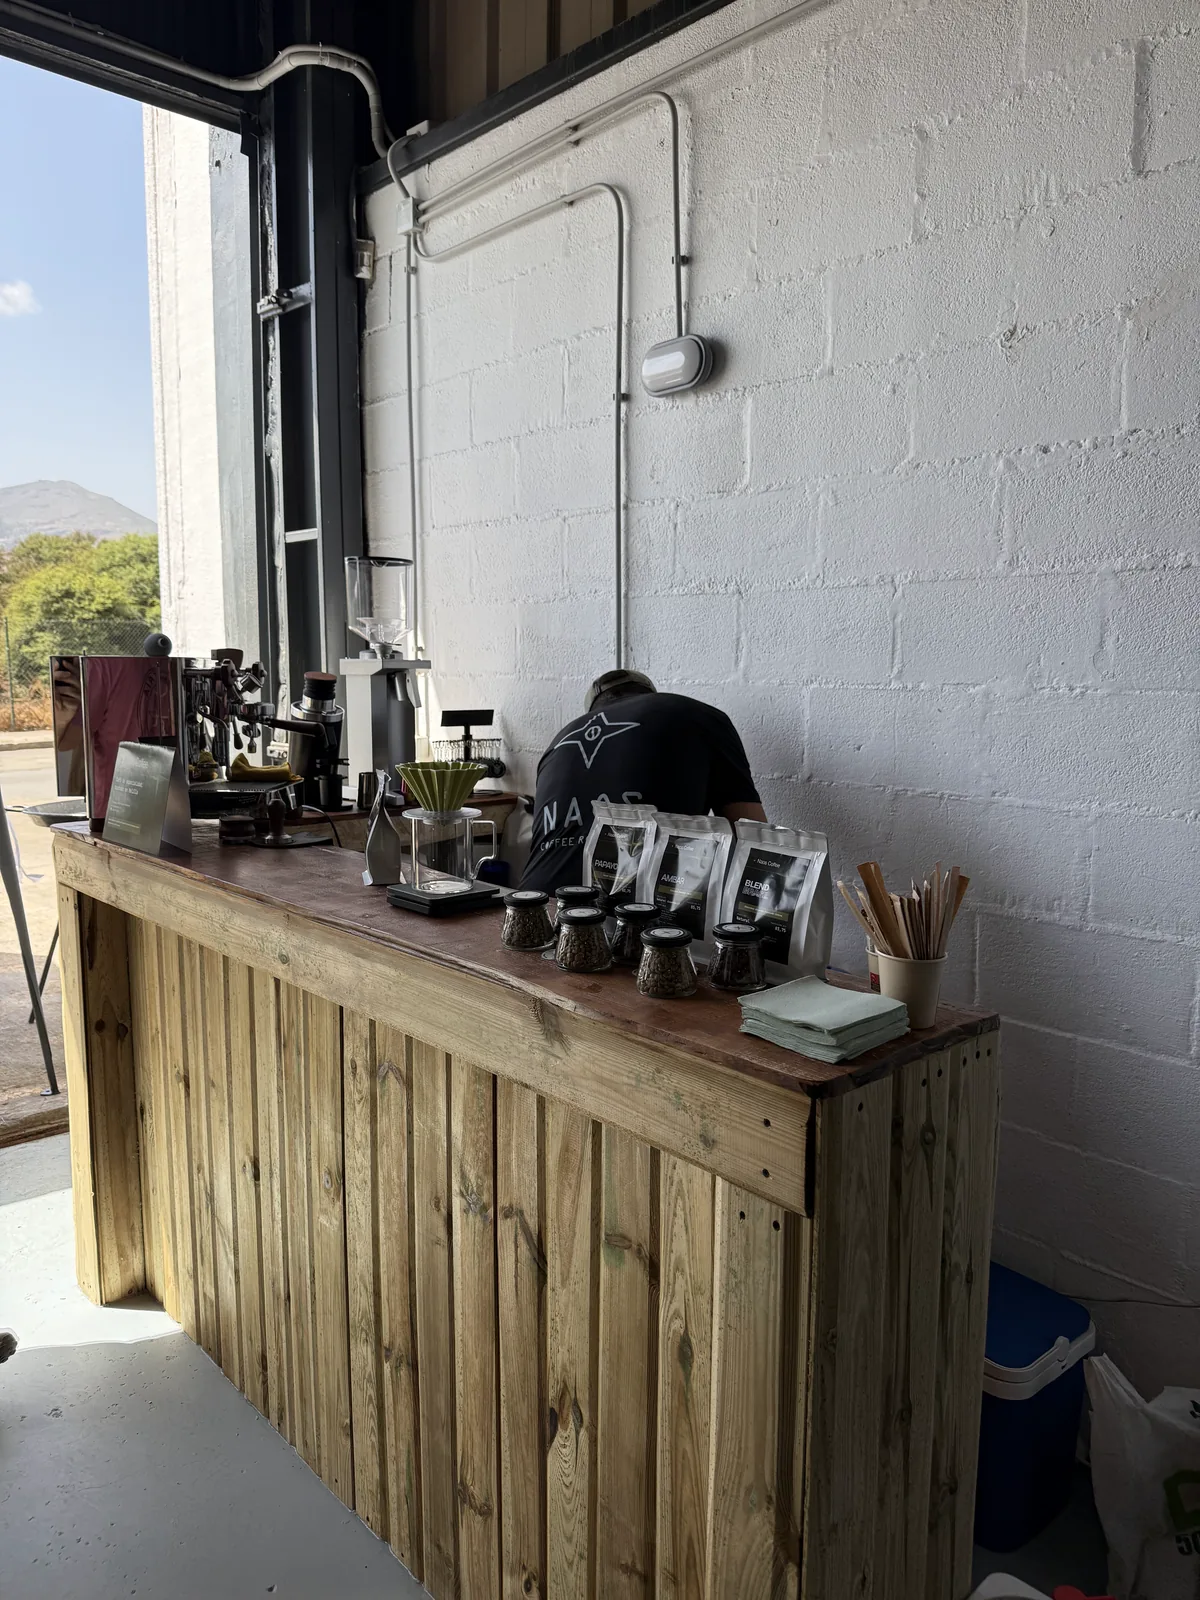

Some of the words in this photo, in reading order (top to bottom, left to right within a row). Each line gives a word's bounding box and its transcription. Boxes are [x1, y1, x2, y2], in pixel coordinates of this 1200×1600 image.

[540, 837, 575, 851] COFFEE
[767, 860, 781, 869] Coffee
[660, 873, 685, 885] AMBAR
[744, 879, 770, 891] BLEND
